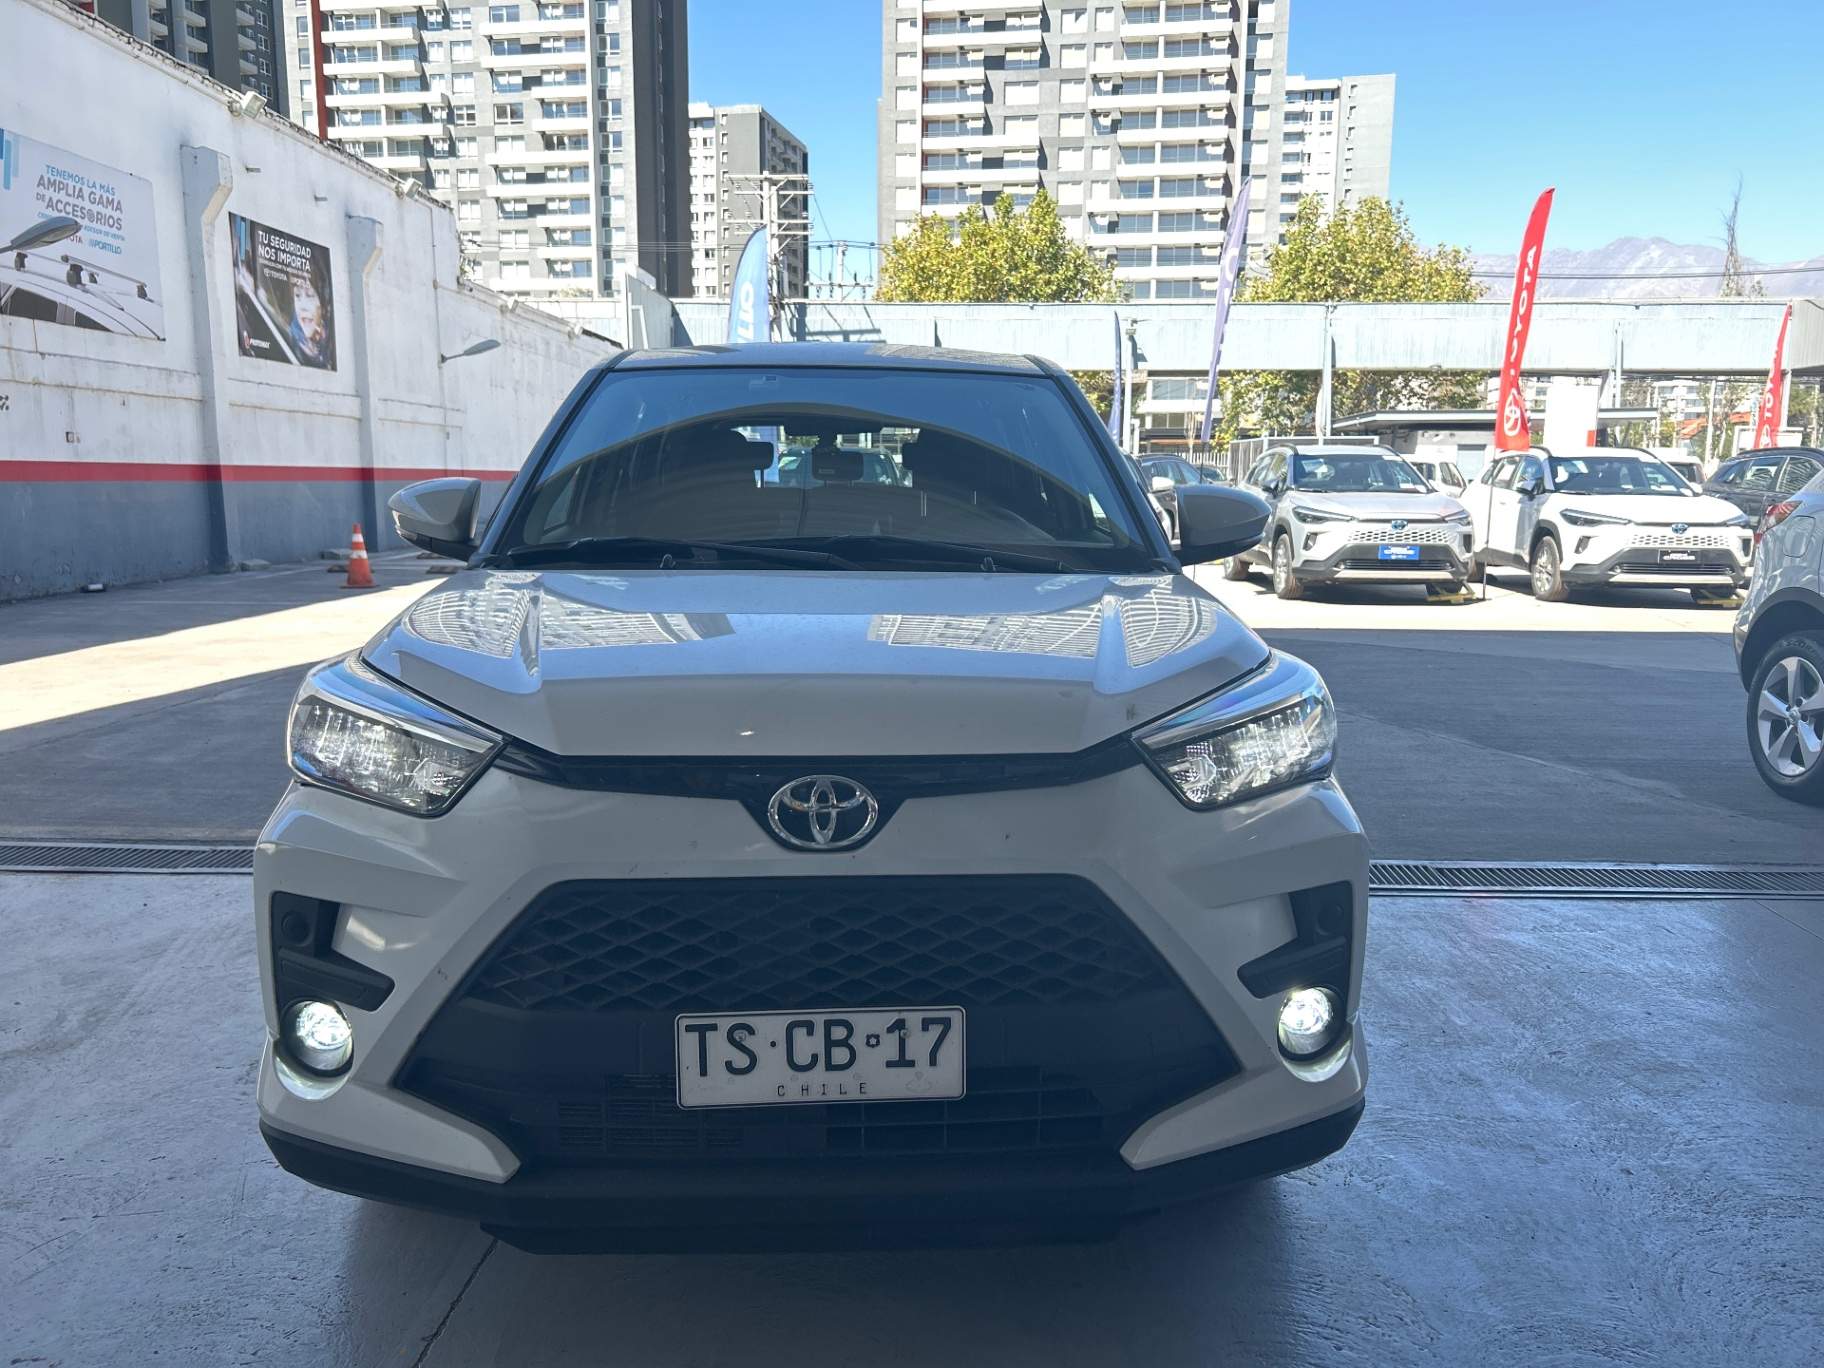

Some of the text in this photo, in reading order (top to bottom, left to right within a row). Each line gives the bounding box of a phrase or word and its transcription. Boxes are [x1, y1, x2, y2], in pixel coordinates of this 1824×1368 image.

[46, 165, 85, 185] TENEMOS
[86, 179, 97, 190] LA
[38, 174, 123, 214] AMPLIA GAMA
[36, 192, 46, 202] DE
[46, 197, 122, 231] ACCESORIOS
[258, 230, 312, 259] TU SEGURIDAD
[258, 245, 276, 261] NOS
[277, 252, 311, 272] IMPORTA
[777, 1082, 867, 1097] CHILE
